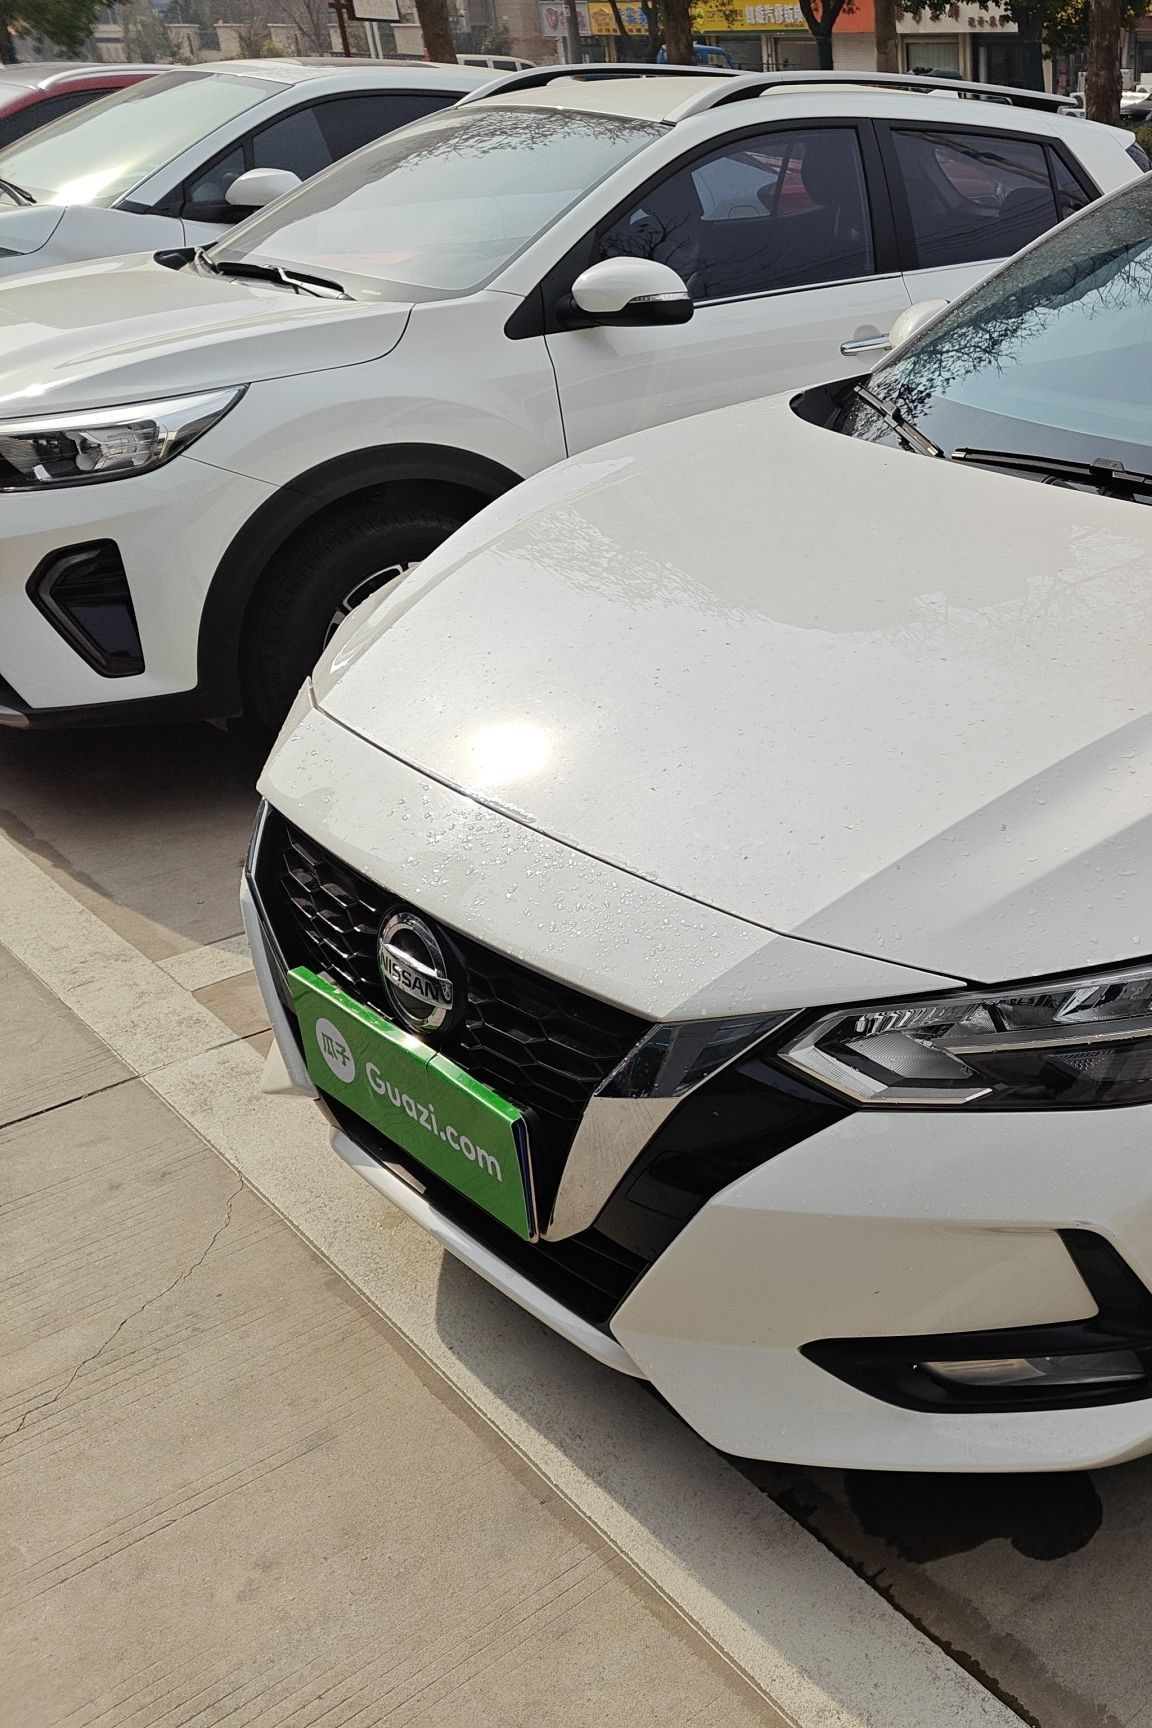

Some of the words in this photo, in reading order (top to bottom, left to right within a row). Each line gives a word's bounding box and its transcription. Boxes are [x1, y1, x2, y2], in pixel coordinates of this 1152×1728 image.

[381, 951, 440, 1002] NISSAN
[321, 1032, 350, 1067] 瓜子
[365, 1061, 503, 1183] Guazi.com
